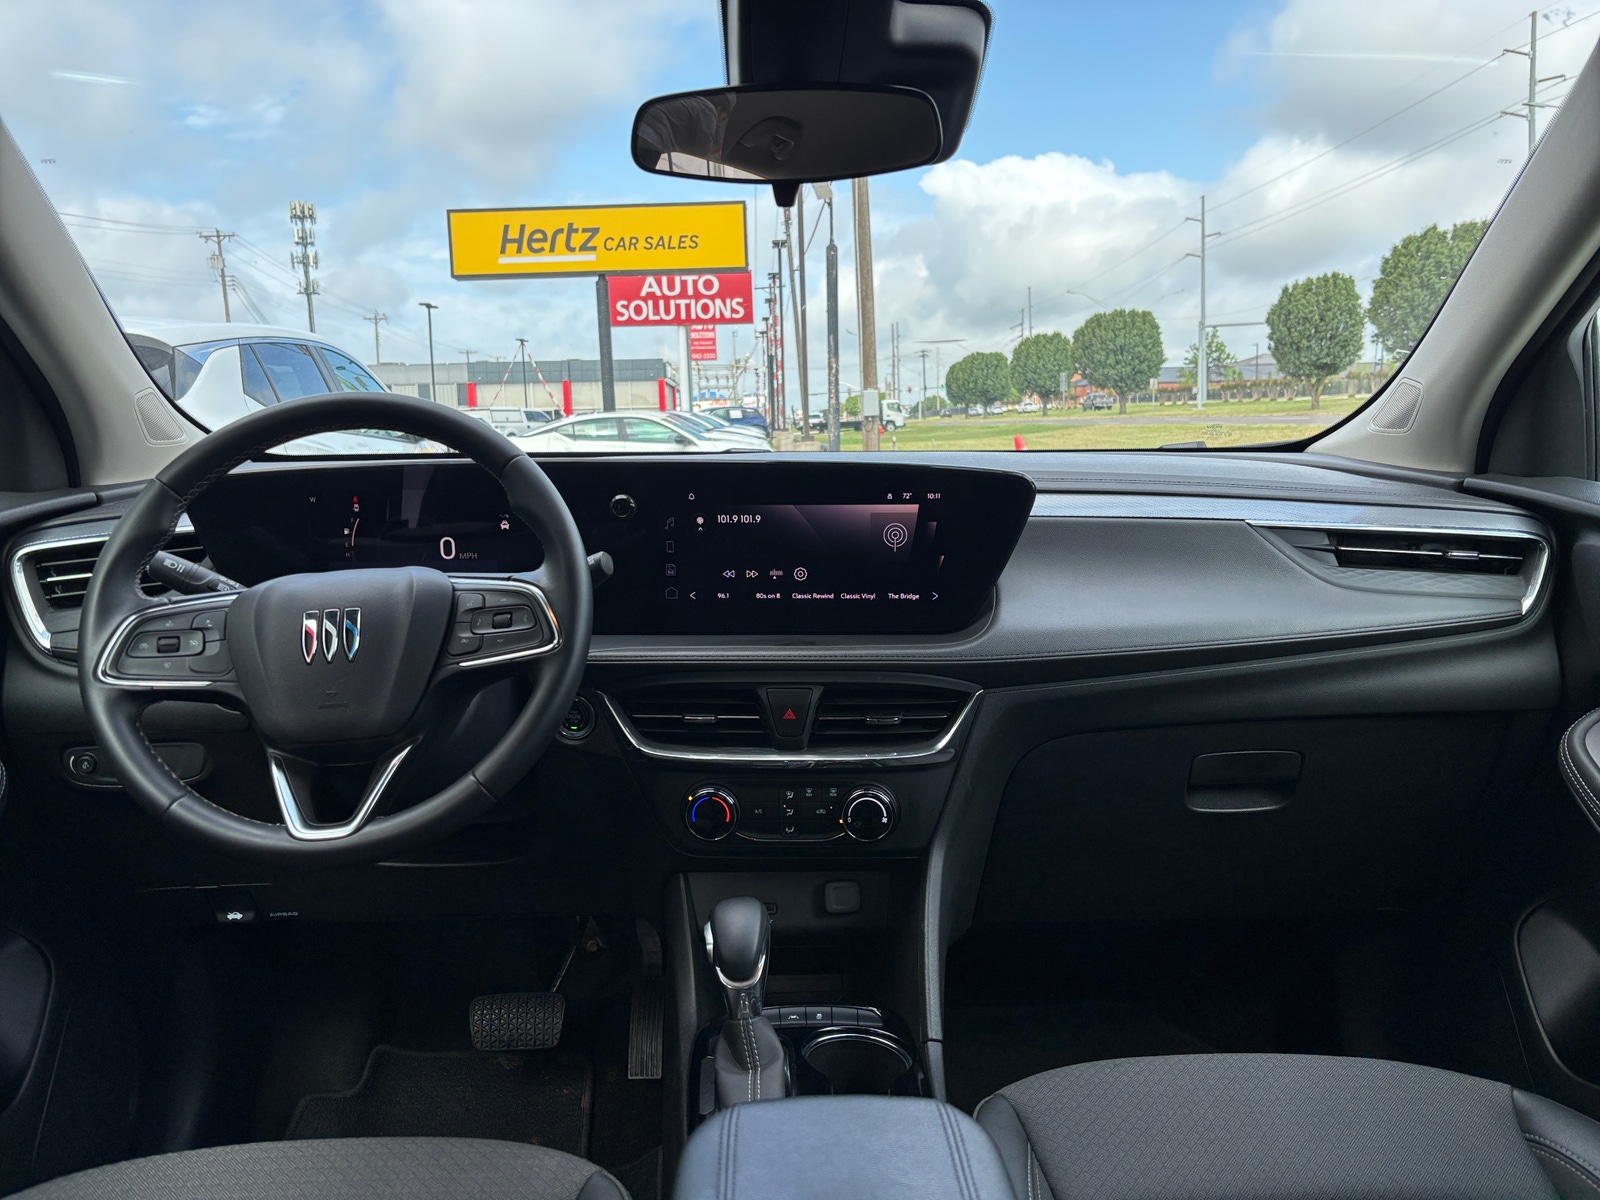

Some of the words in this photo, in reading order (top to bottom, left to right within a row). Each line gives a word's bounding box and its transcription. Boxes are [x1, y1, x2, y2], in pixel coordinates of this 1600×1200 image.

[500, 222, 600, 254] Hertz
[604, 236, 639, 251] CAR
[643, 234, 699, 251] SALES
[640, 275, 719, 297] AUTO
[615, 297, 745, 321] SOLUTIONS
[927, 492, 941, 500] 10:11
[717, 514, 739, 524] 101.9
[740, 514, 762, 524] 101.9
[439, 536, 456, 560] 0
[459, 552, 478, 560] MPH
[791, 592, 811, 600] Classic
[812, 592, 835, 600] Rewind
[840, 592, 860, 600] Classic
[861, 592, 876, 601] Vinyl
[888, 592, 899, 600] The
[899, 592, 920, 601] Bridge
